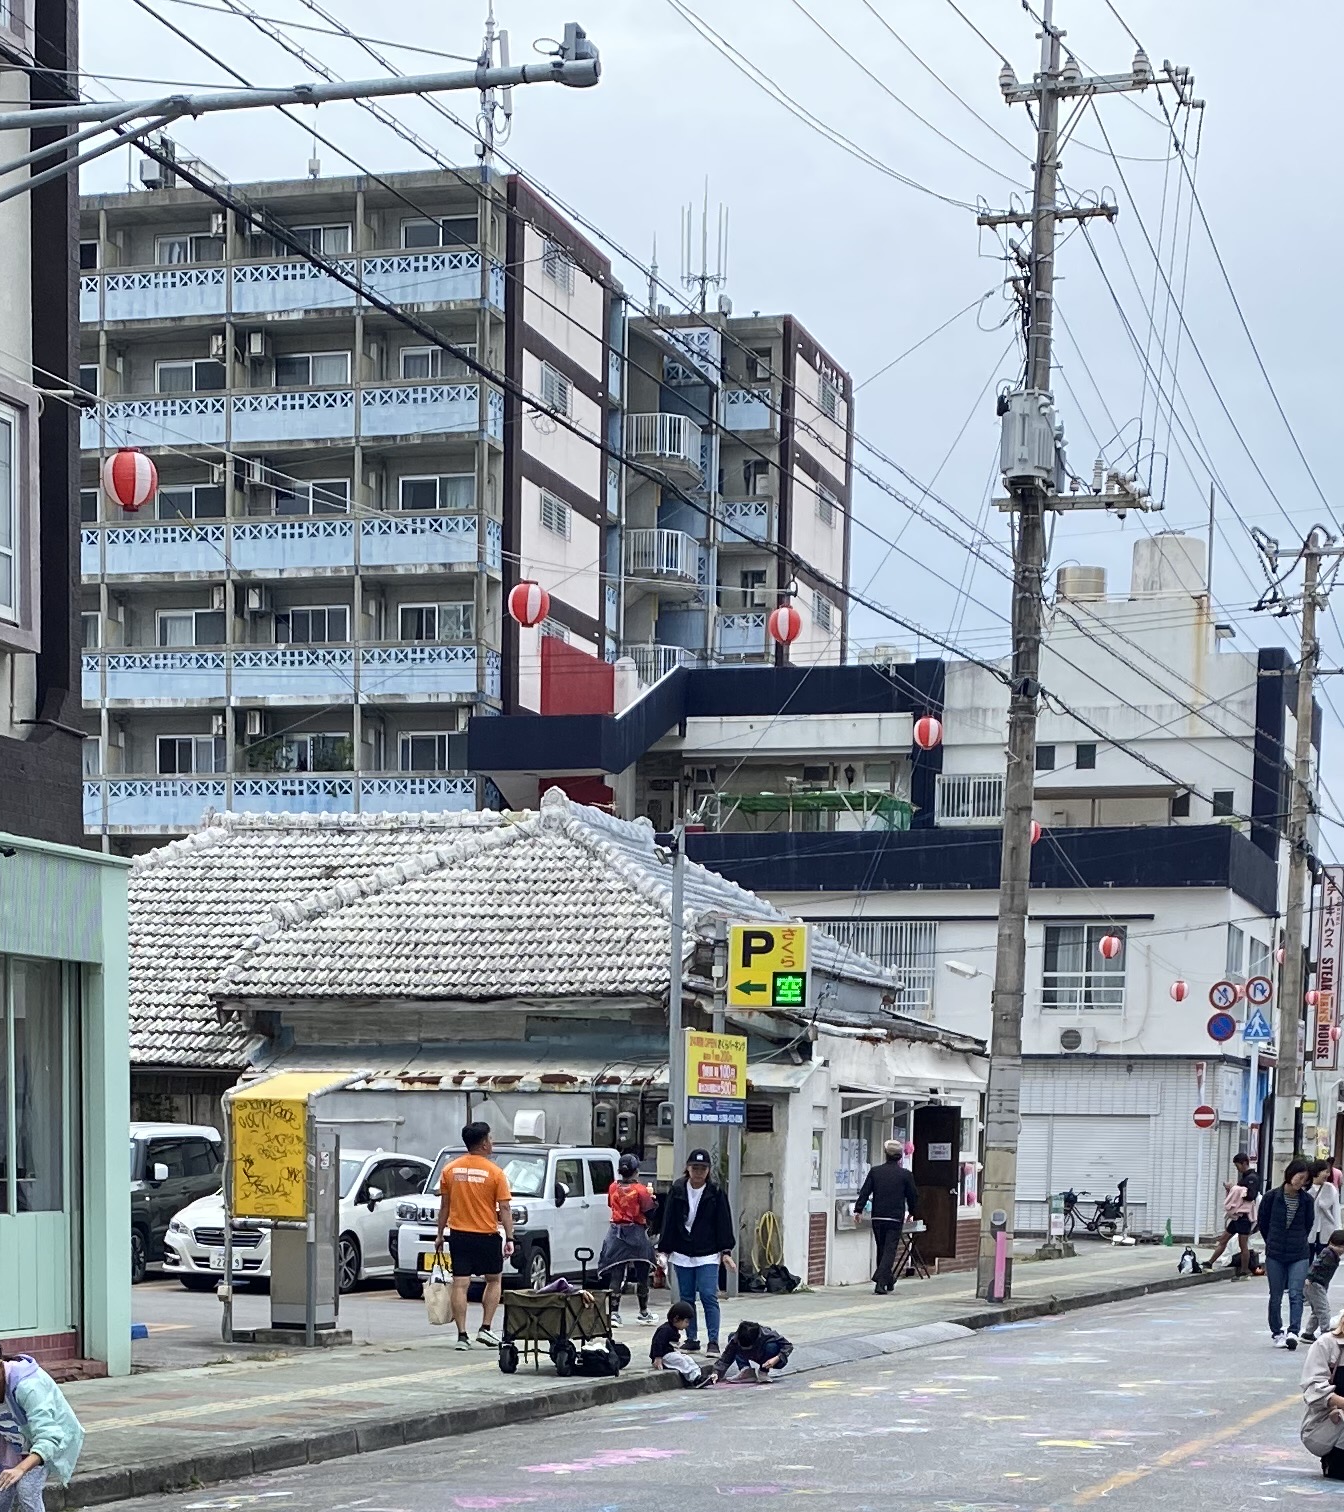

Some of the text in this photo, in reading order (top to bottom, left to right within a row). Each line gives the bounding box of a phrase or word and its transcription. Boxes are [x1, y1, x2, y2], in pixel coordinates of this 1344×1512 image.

[742, 931, 774, 968] P
[776, 975, 803, 1002] 空
[1320, 957, 1333, 991] STEAK
[1317, 1024, 1330, 1060] HOUSE
